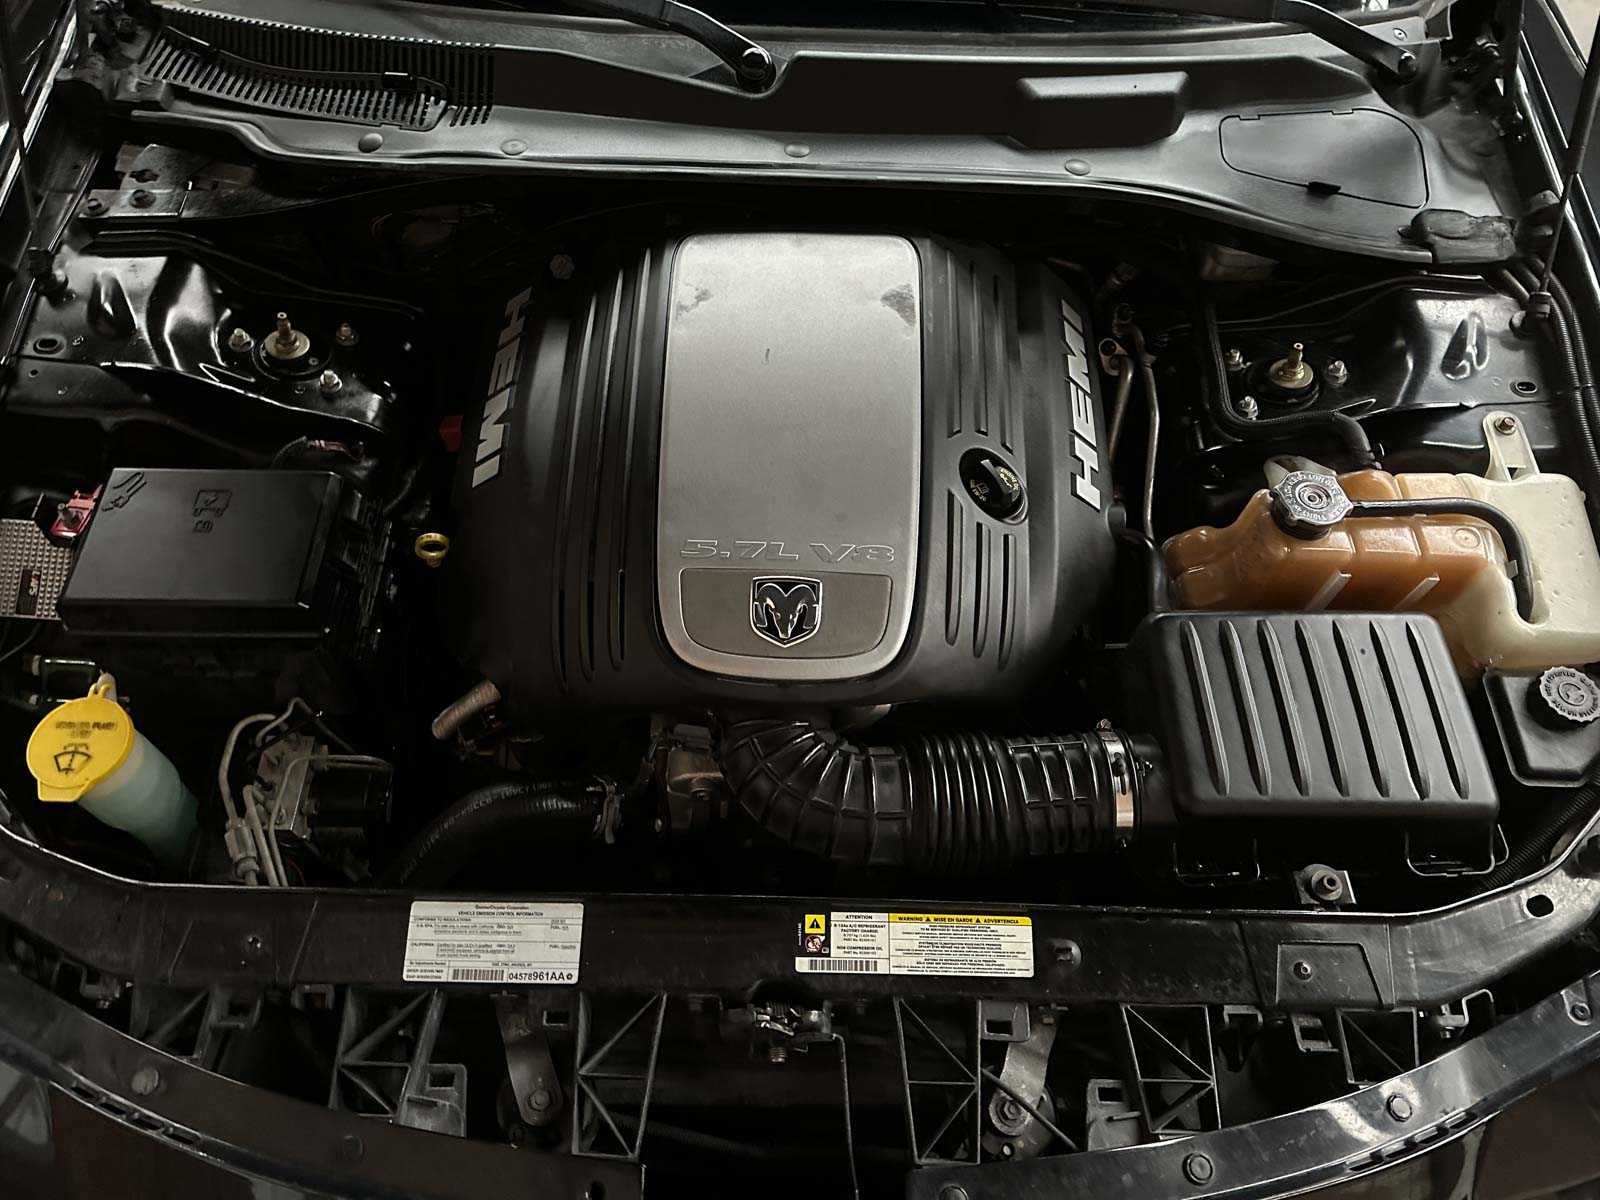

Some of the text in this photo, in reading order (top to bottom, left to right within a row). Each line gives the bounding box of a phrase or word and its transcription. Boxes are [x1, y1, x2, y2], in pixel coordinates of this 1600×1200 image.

[472, 286, 533, 488] HEMI
[1061, 299, 1101, 512] HEMI
[679, 538, 895, 563] 5.7L V8
[508, 971, 565, 981] 04578961AA
